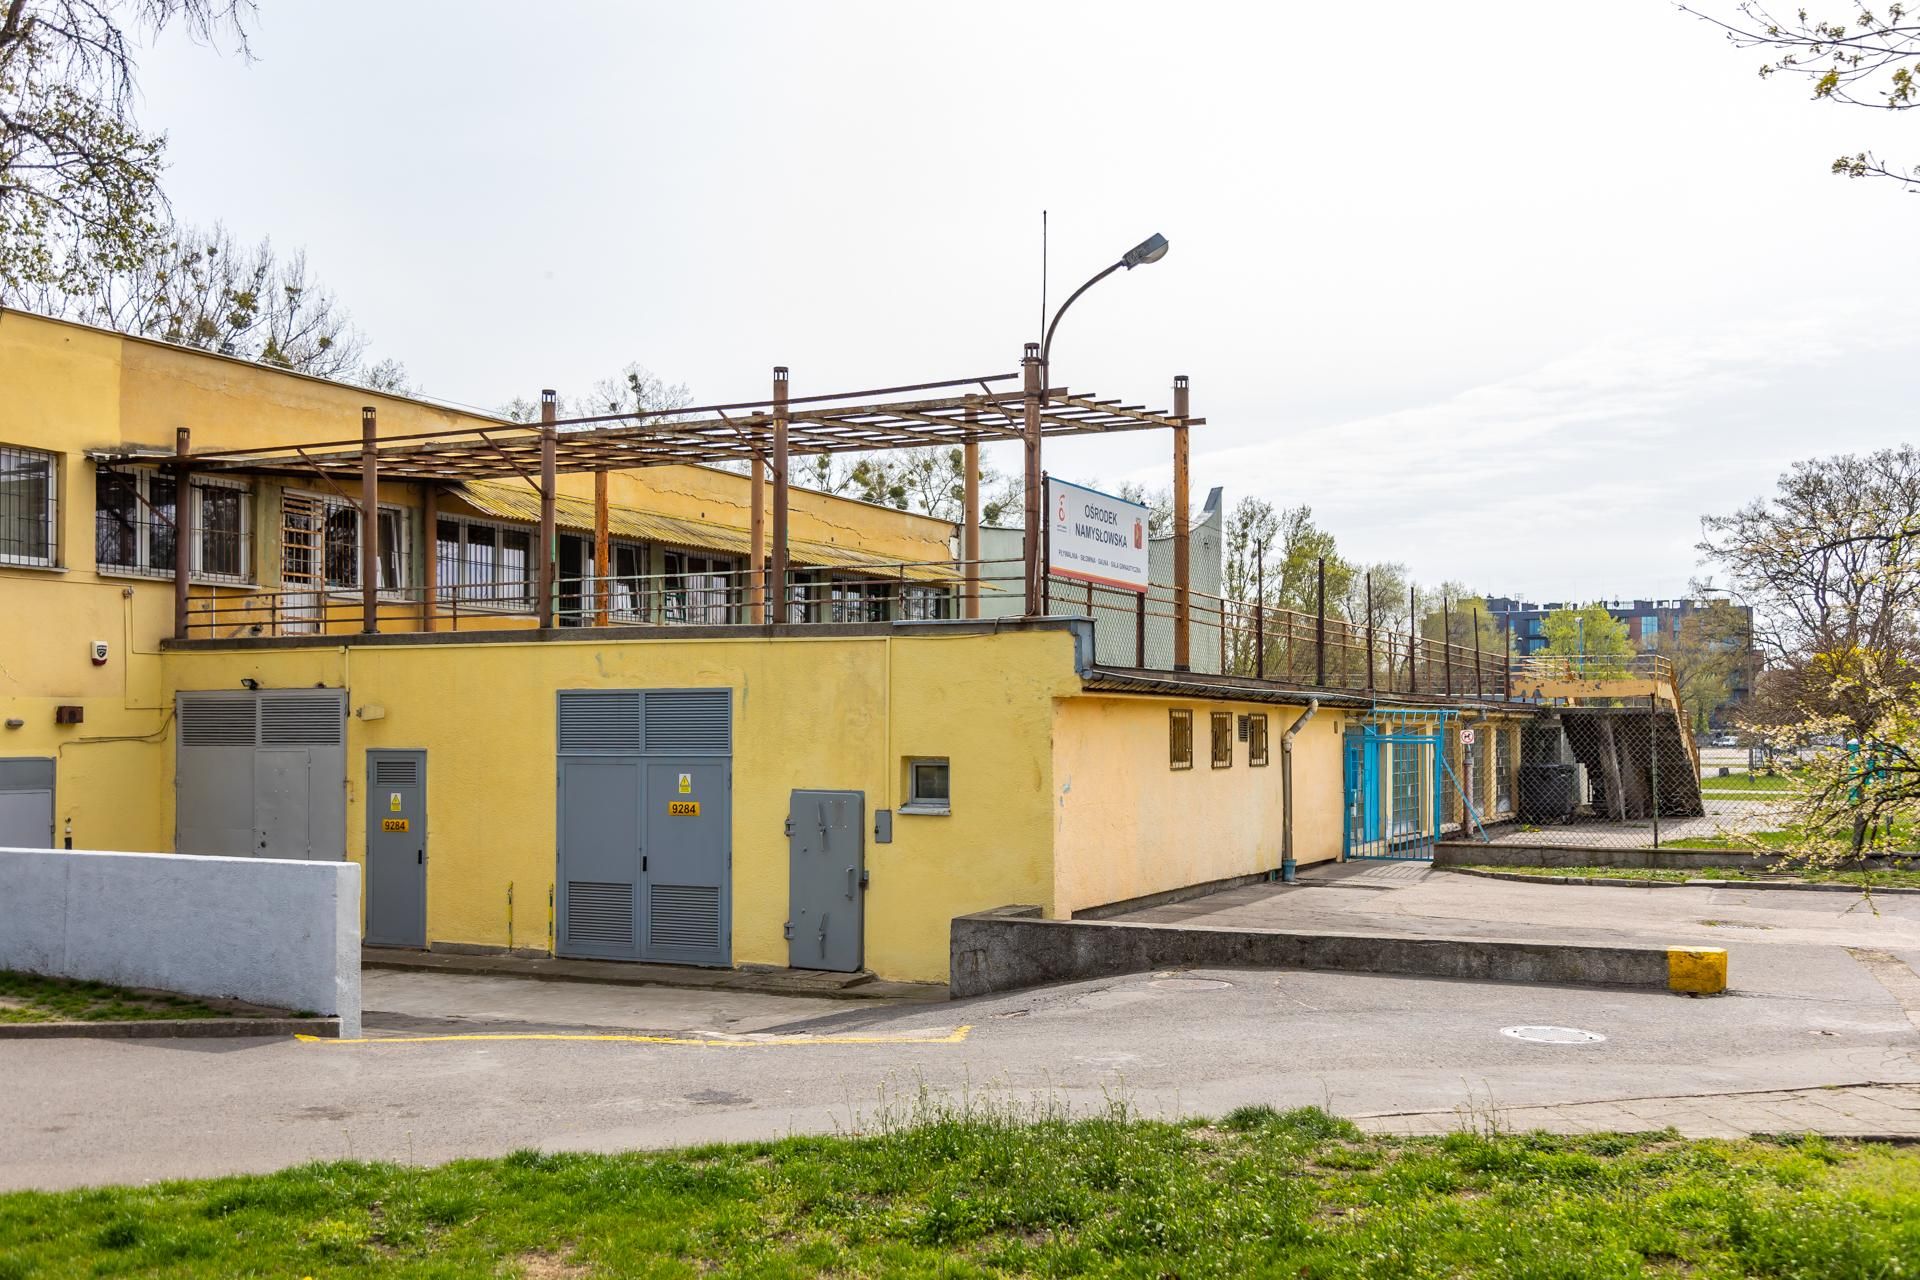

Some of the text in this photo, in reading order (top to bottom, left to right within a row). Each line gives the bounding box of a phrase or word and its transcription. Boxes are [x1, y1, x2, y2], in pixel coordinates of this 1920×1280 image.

[1084, 504, 1118, 526] OŚRODEK
[1075, 523, 1127, 548] NAMYSŁOWSKA
[672, 803, 697, 814] 9284
[384, 821, 405, 830] 9284
